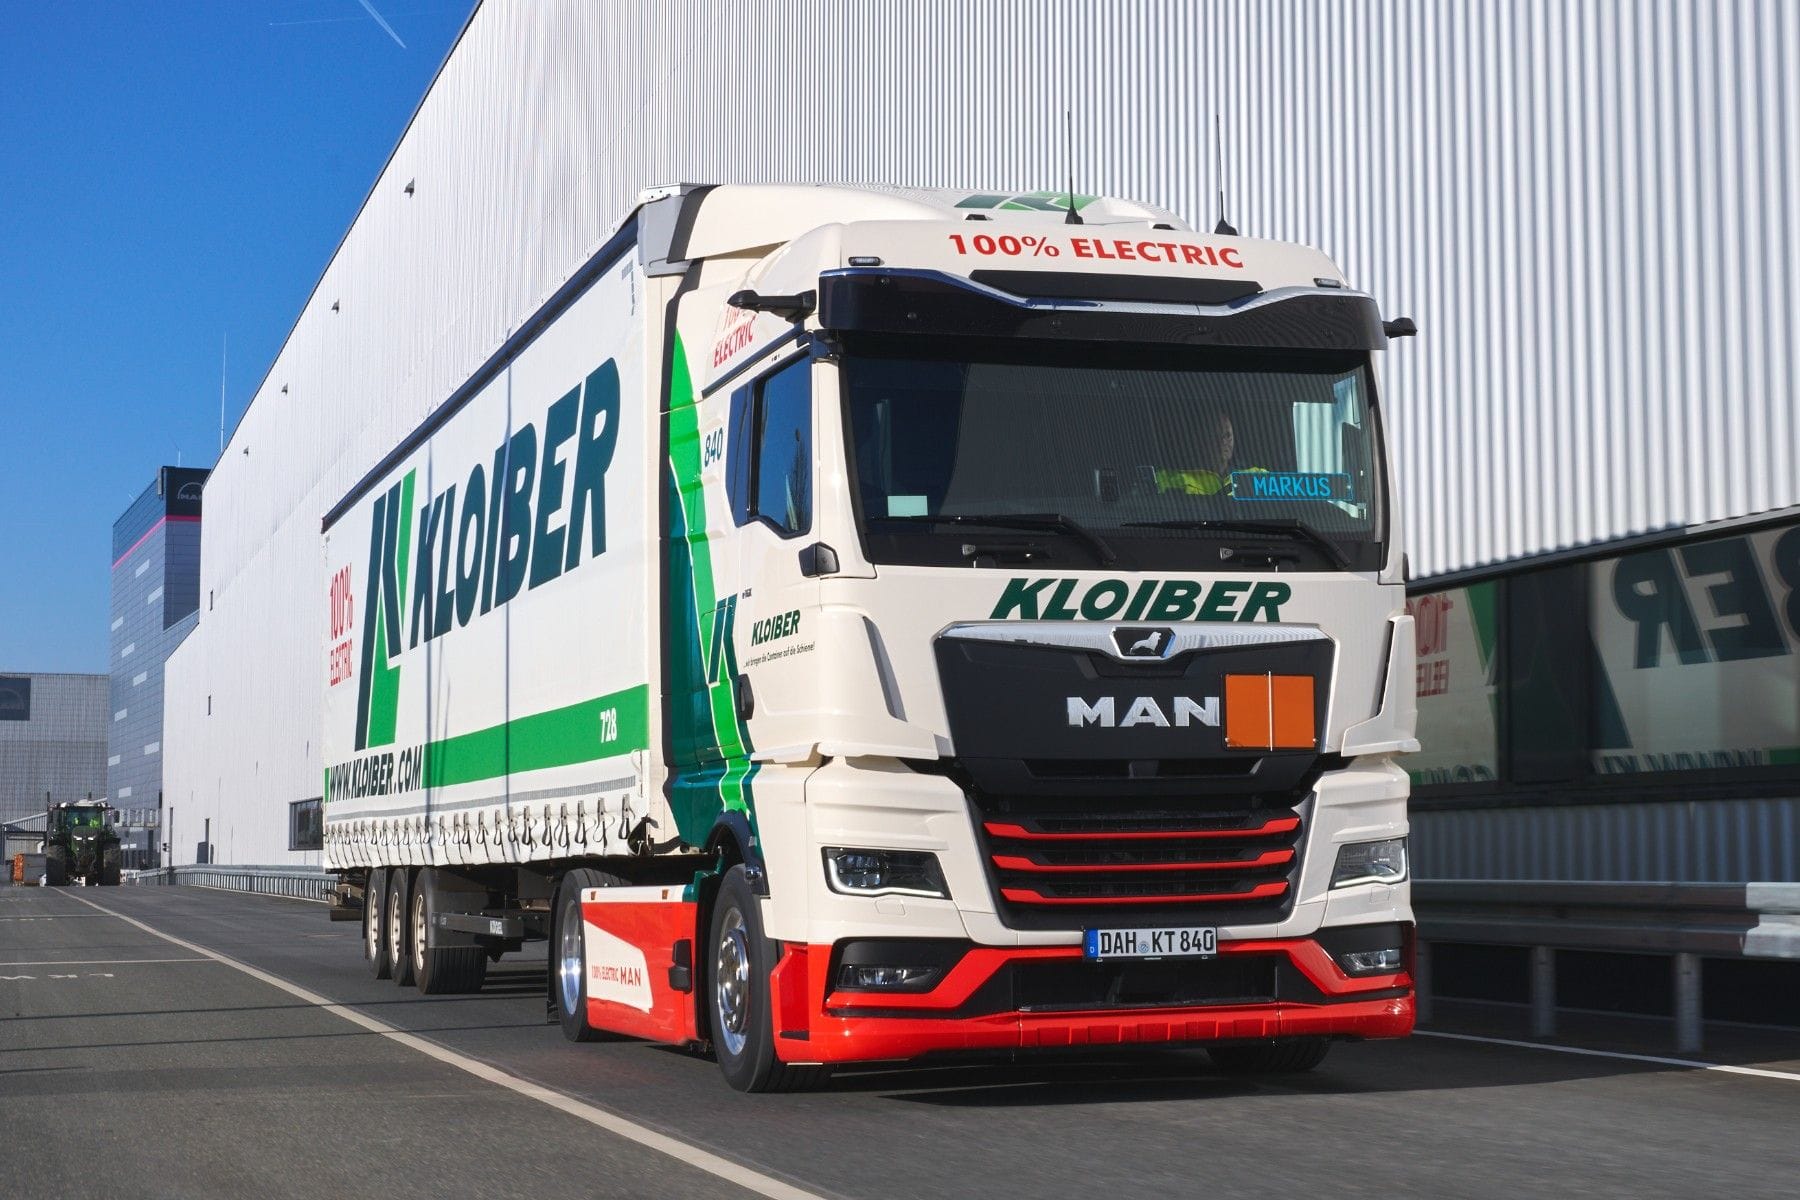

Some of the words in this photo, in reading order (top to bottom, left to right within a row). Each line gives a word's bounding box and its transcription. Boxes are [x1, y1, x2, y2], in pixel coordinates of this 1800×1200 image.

[948, 234, 1060, 258] 100%
[1070, 238, 1244, 268] ELECTRIC
[713, 314, 757, 368] ELECTRIC
[704, 427, 723, 467] 840
[409, 357, 621, 650] KLOIBER
[1253, 476, 1331, 497] MARKUS
[330, 562, 353, 640] 100%
[988, 578, 1292, 622] KLOIBER
[751, 609, 801, 647] KLOIBER
[330, 638, 353, 686] ELECTRIC
[600, 707, 618, 743] 728
[1066, 696, 1220, 728] MAN
[329, 745, 423, 803] WWW.KLOIBER.COM
[1100, 931, 1137, 954] DAH
[1151, 931, 1175, 953] KT
[1180, 930, 1214, 952] 840
[620, 966, 641, 987] MAN
